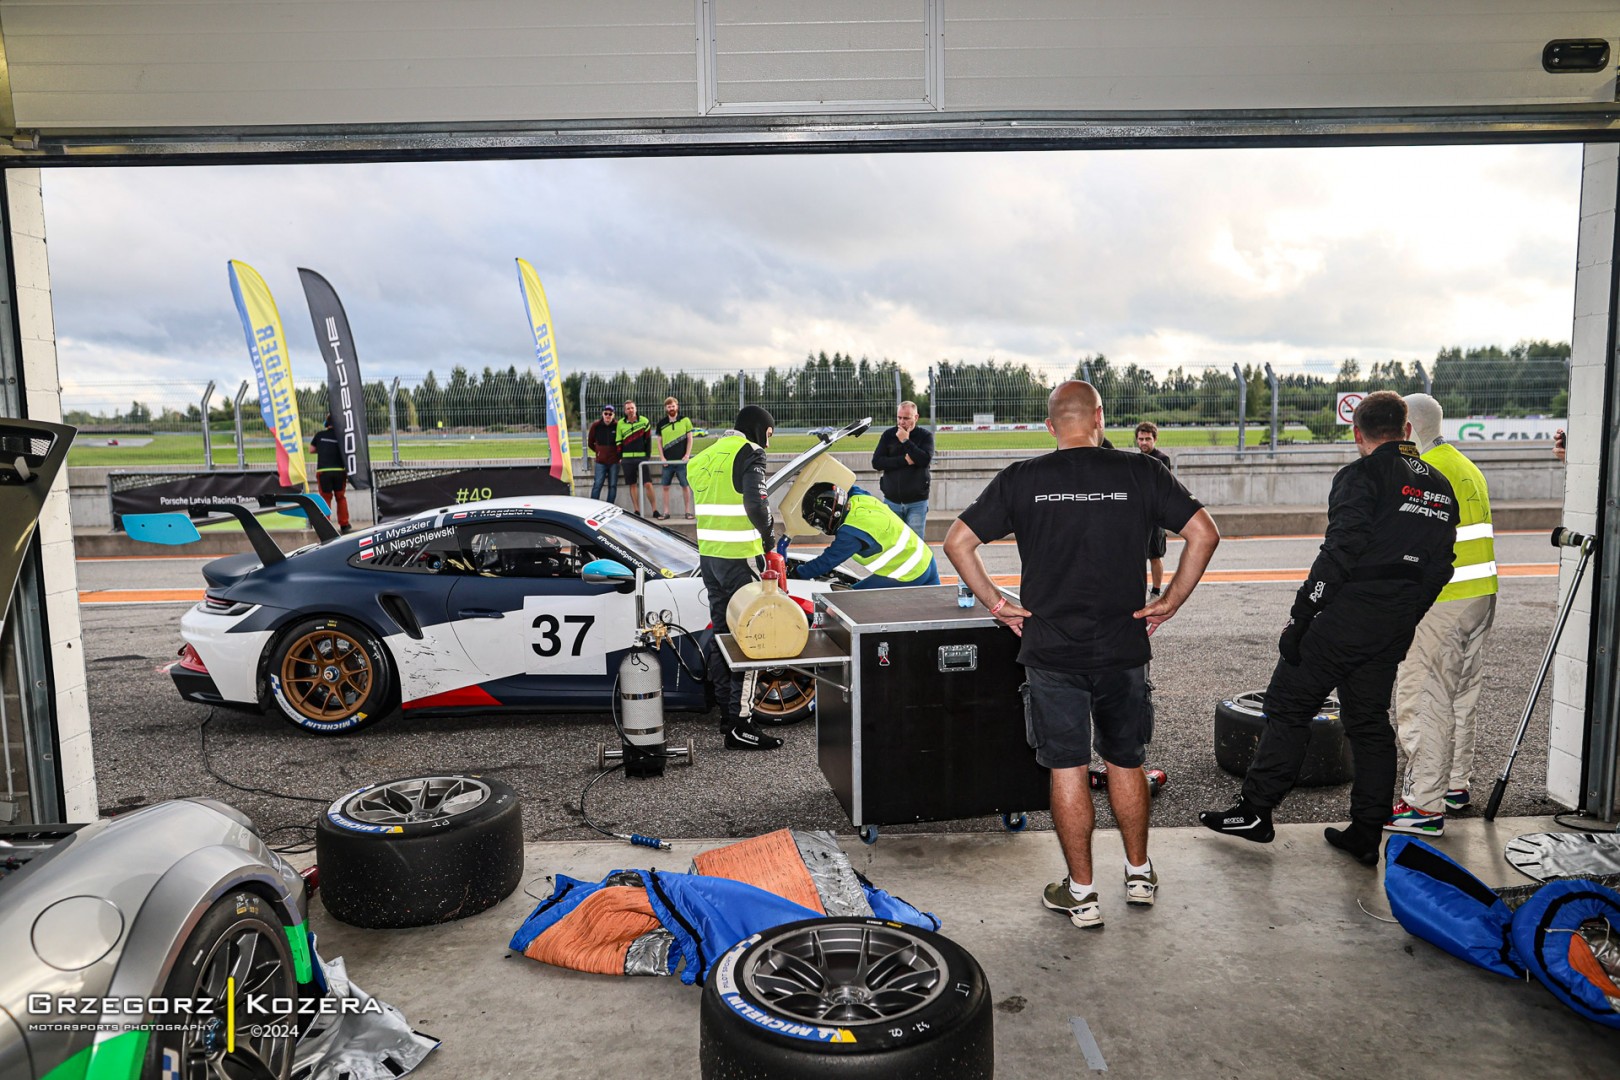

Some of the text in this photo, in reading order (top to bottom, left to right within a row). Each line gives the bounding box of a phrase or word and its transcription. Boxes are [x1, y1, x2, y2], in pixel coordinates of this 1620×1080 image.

[160, 496, 187, 505] Porsche
[189, 496, 210, 504] Latvia
[237, 495, 256, 503] Team
[456, 487, 492, 504] #49
[1035, 492, 1128, 503] PORSCHE
[374, 519, 431, 543] T. Myszkier
[375, 526, 455, 556] M. Nierychlewski
[532, 614, 595, 657] 37
[305, 720, 351, 730] MICHELIN
[330, 813, 378, 831] MICHELIN
[722, 955, 733, 989] PILOT SPORT
[727, 995, 814, 1037] MICHELIN
